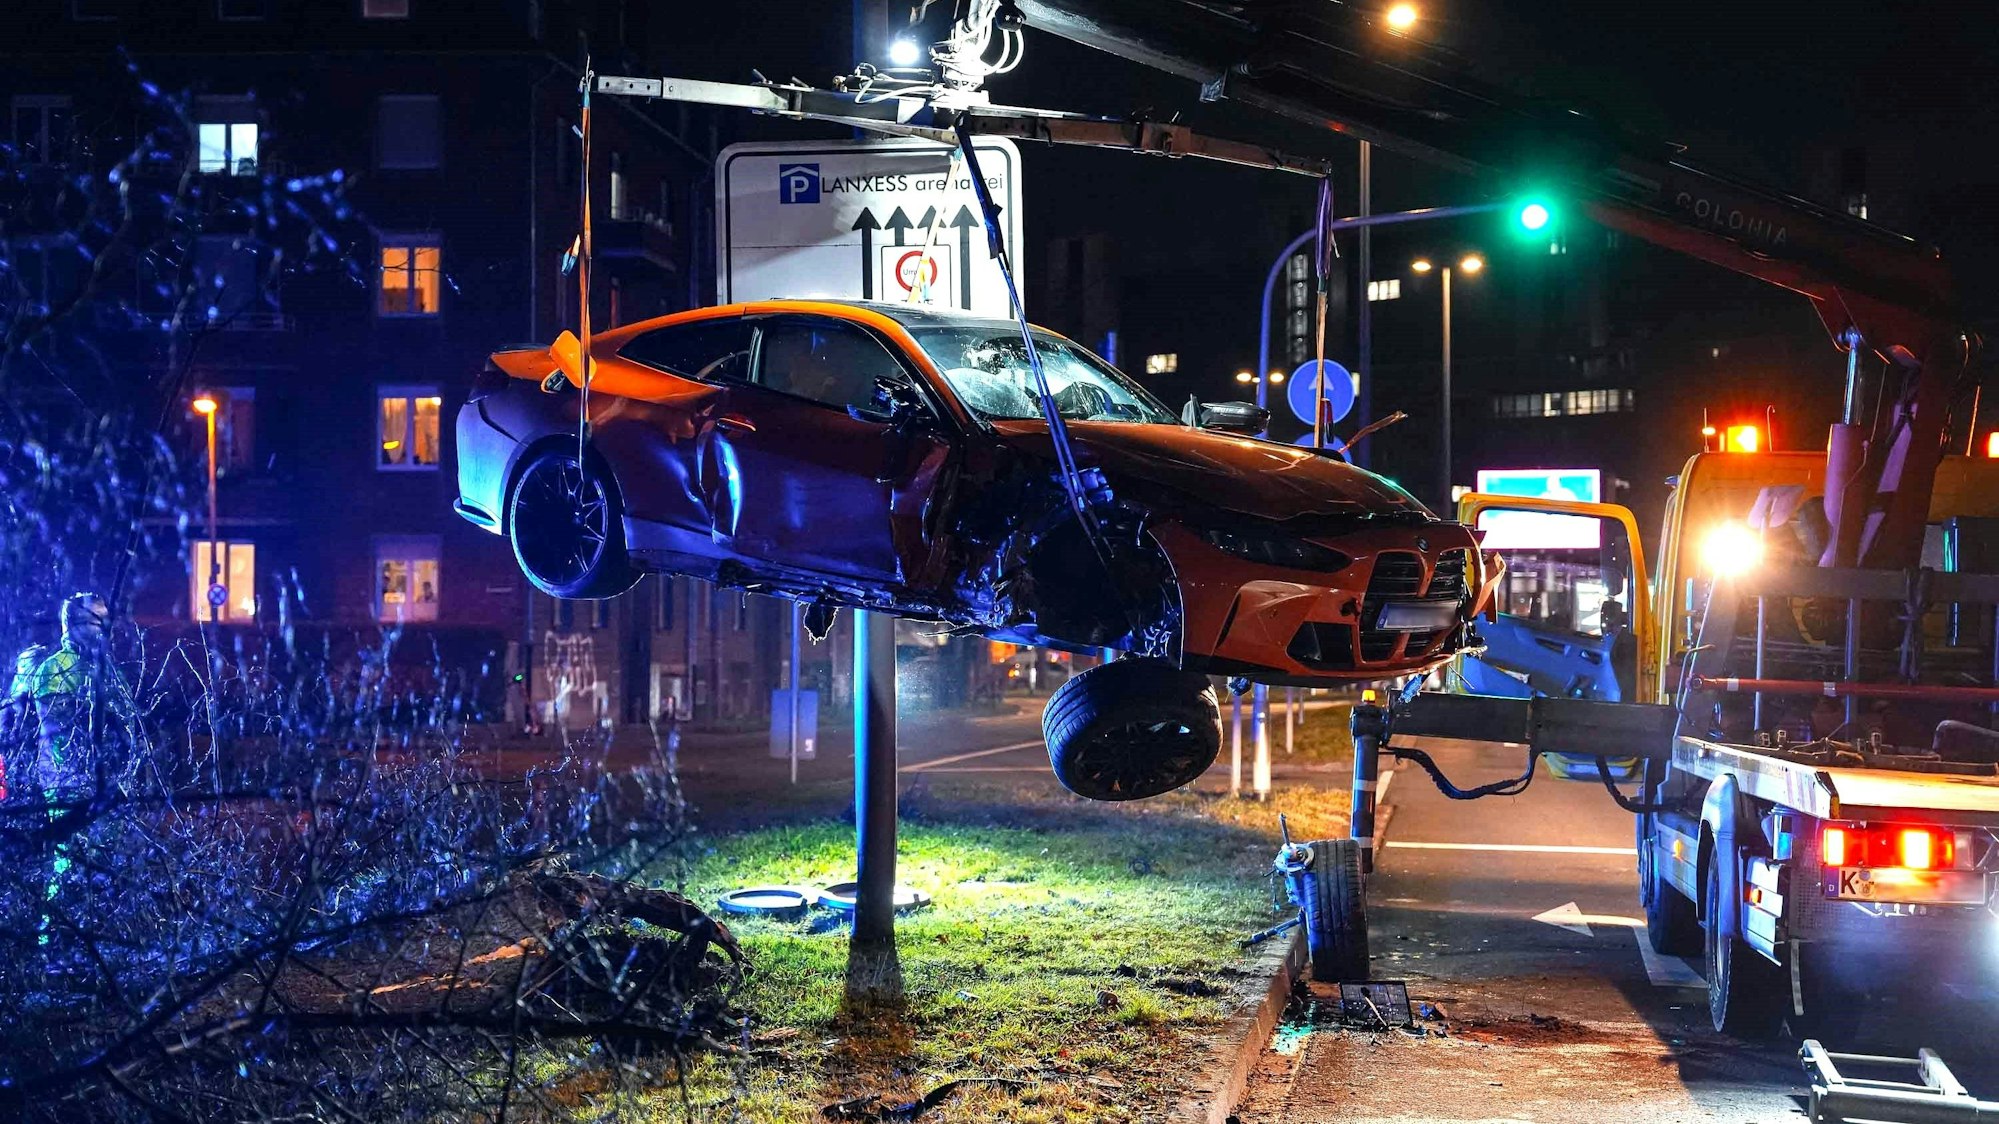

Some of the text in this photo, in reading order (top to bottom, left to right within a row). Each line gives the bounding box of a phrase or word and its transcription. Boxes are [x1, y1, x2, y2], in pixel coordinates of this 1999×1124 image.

[790, 175, 809, 202] P
[822, 175, 908, 193] LANXESS
[1676, 192, 1787, 247] COLONIA
[1841, 871, 1857, 895] K
